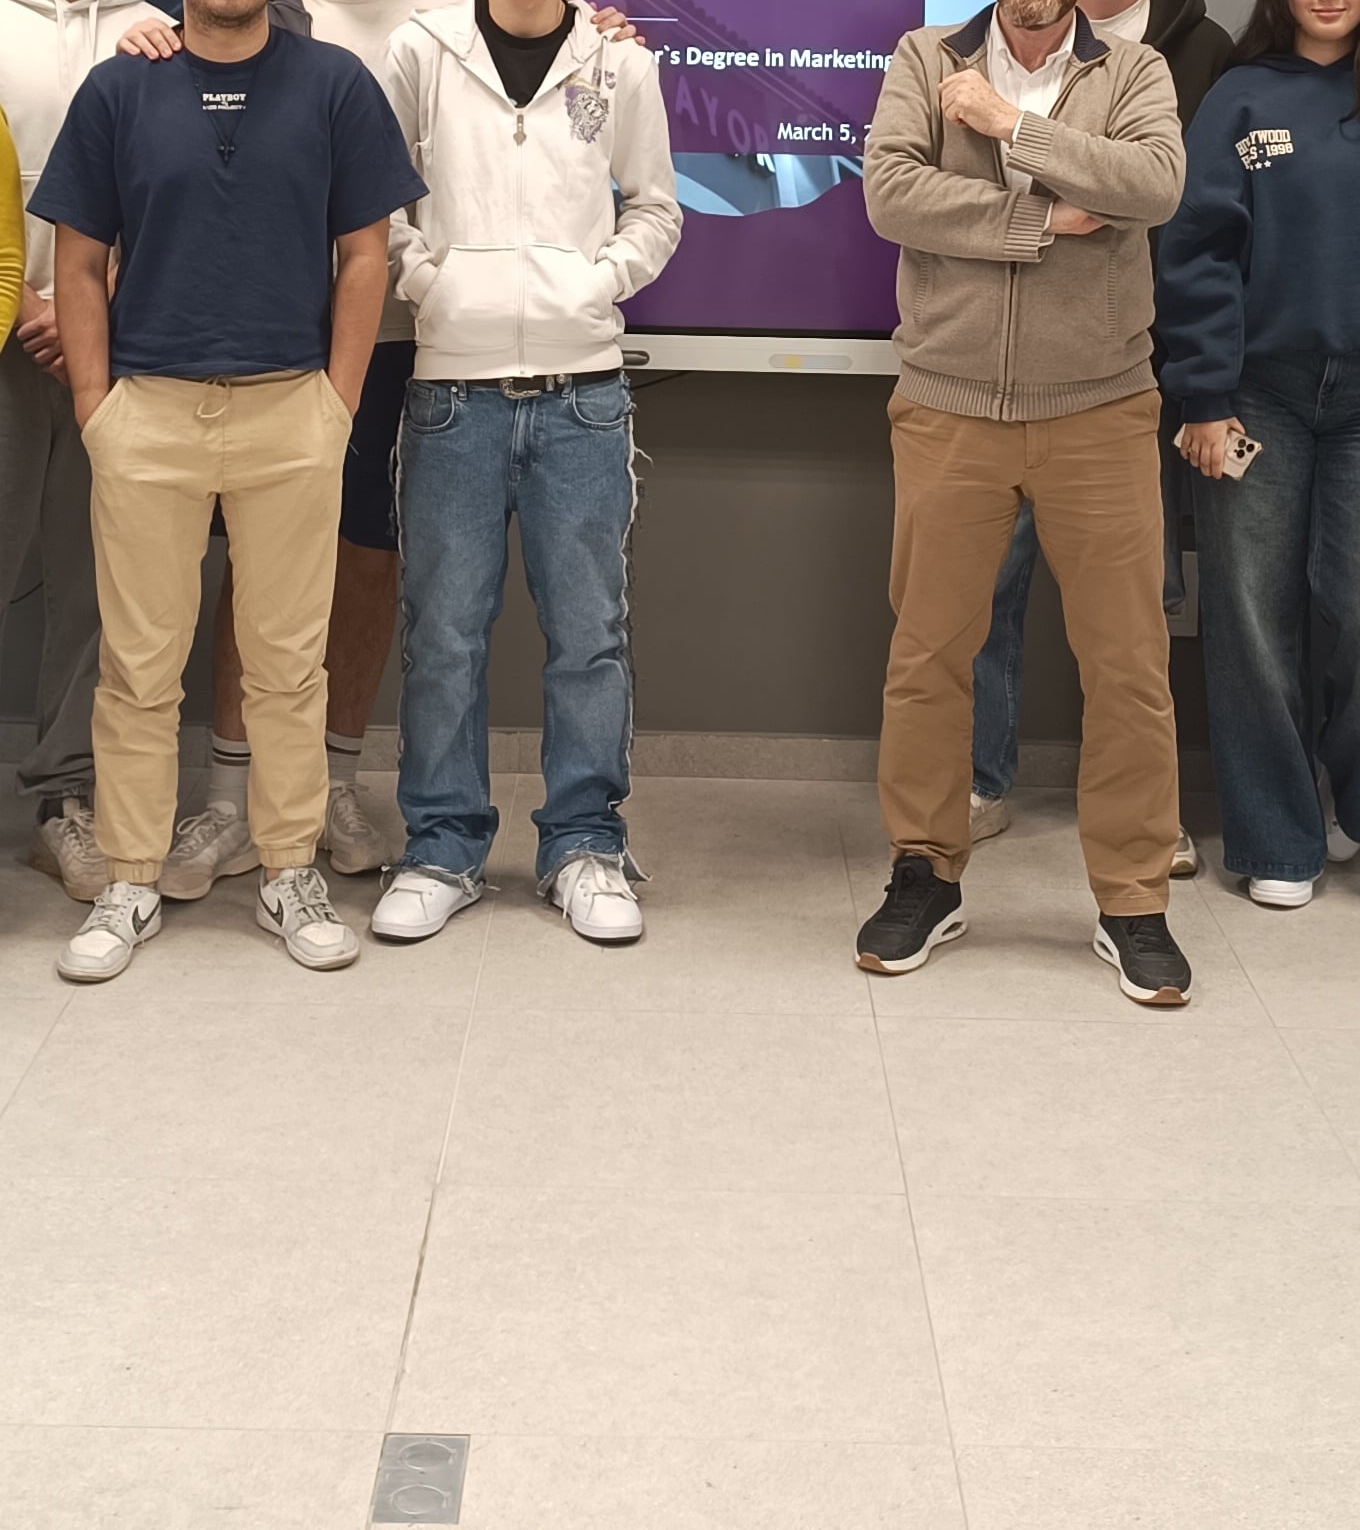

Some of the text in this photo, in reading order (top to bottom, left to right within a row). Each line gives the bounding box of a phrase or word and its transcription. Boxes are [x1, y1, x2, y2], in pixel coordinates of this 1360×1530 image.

[686, 47, 759, 69] Degree
[765, 47, 784, 67] in
[202, 93, 247, 102] PLAYBOY
[777, 122, 833, 141] March
[839, 124, 857, 144] 5,
